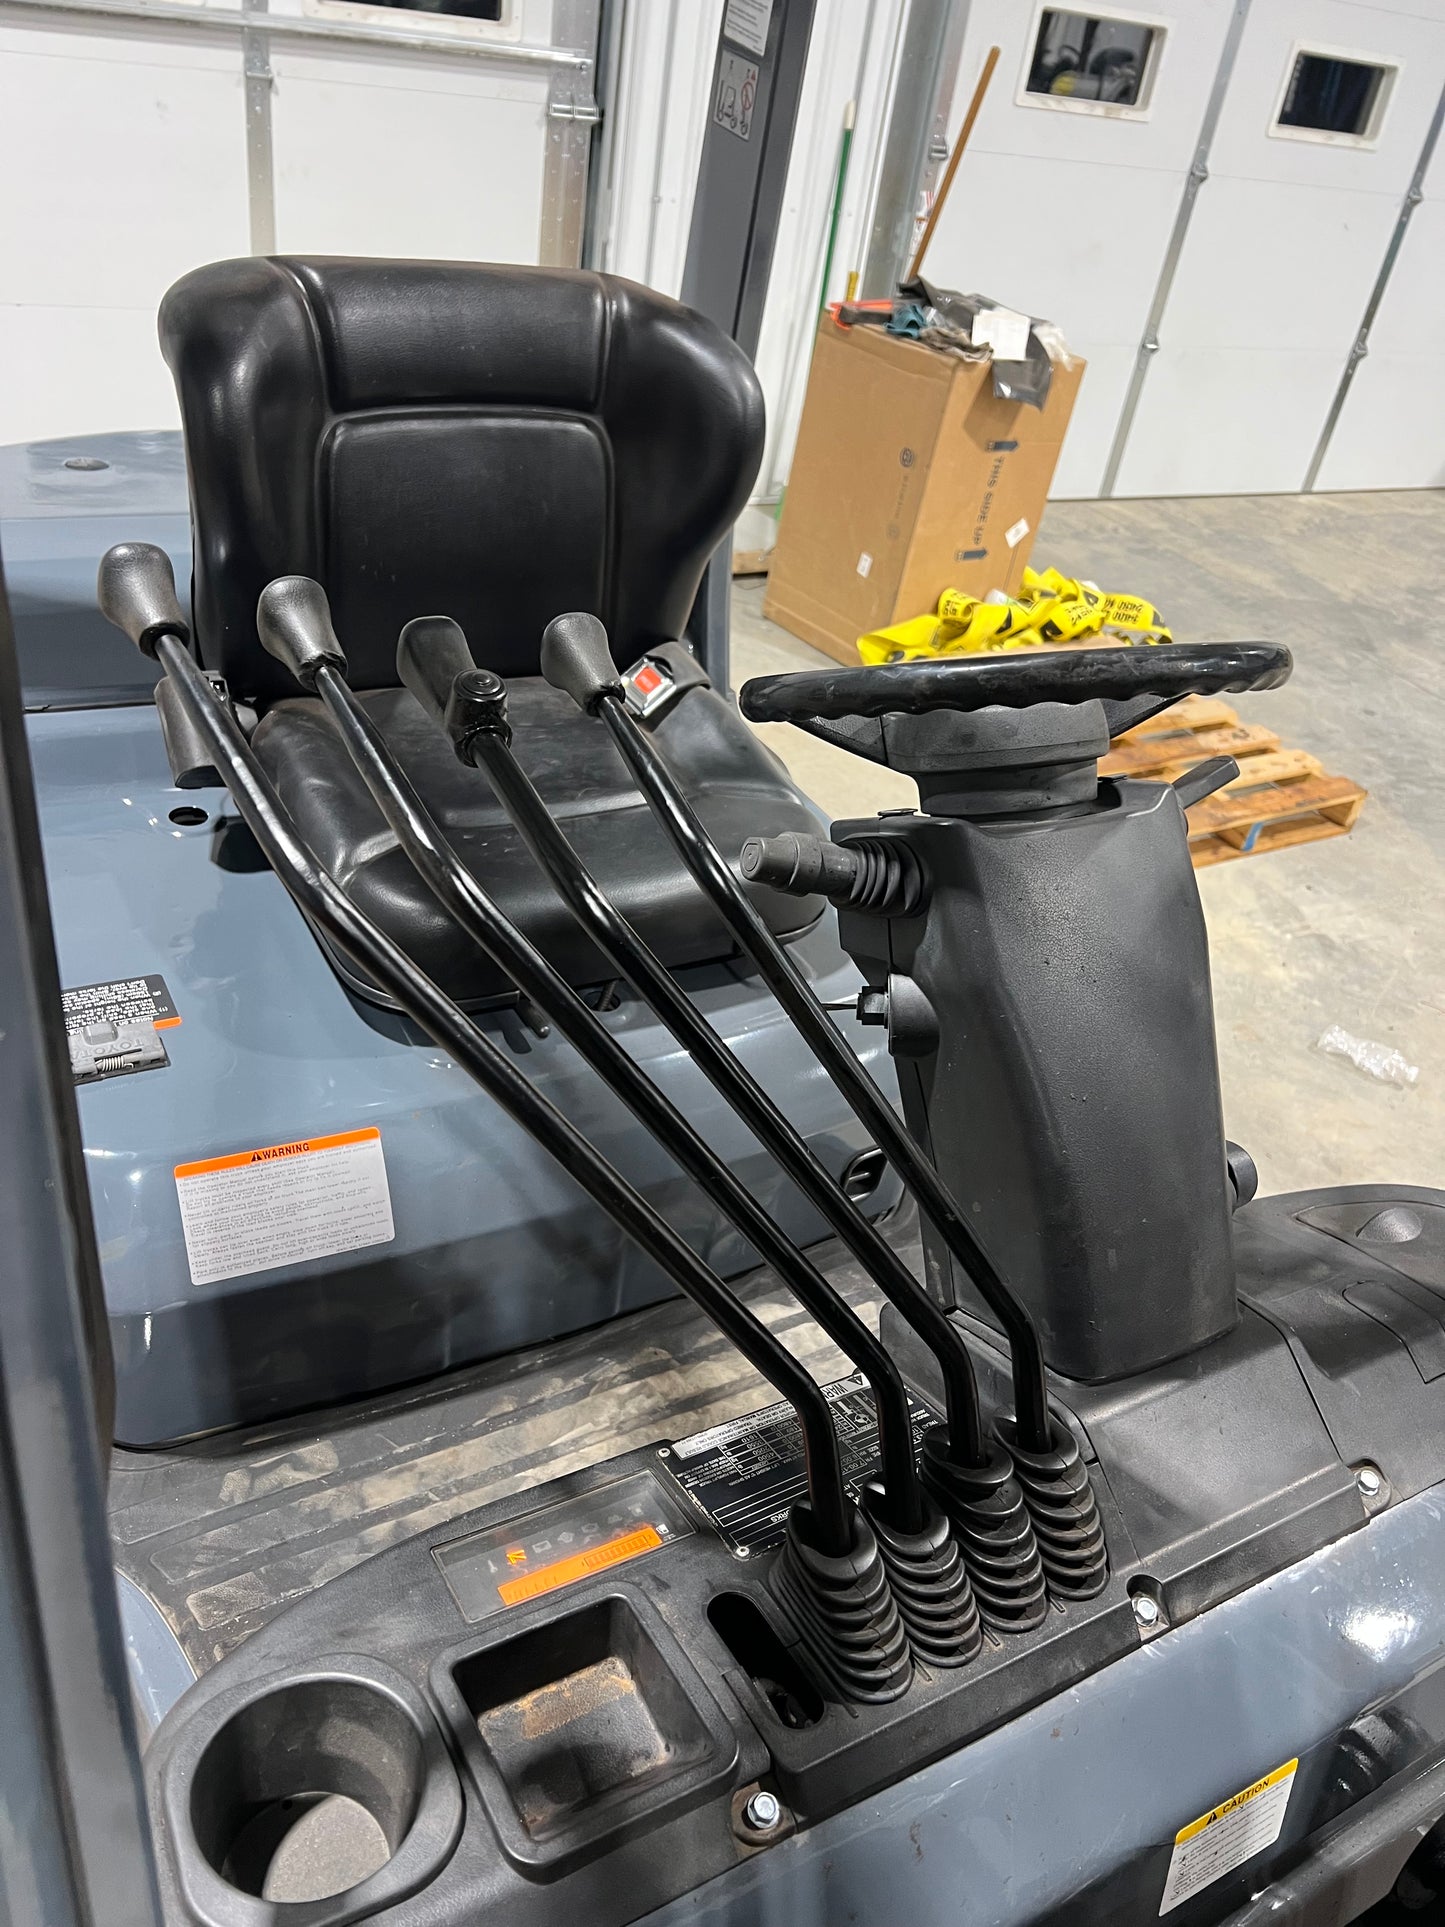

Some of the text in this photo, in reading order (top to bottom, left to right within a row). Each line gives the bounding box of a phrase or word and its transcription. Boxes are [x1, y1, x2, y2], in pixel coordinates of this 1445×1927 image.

[973, 456, 1005, 547] THIS SIDE UP
[262, 1143, 310, 1159] WARNING
[1222, 1778, 1270, 1814] CAUTION
